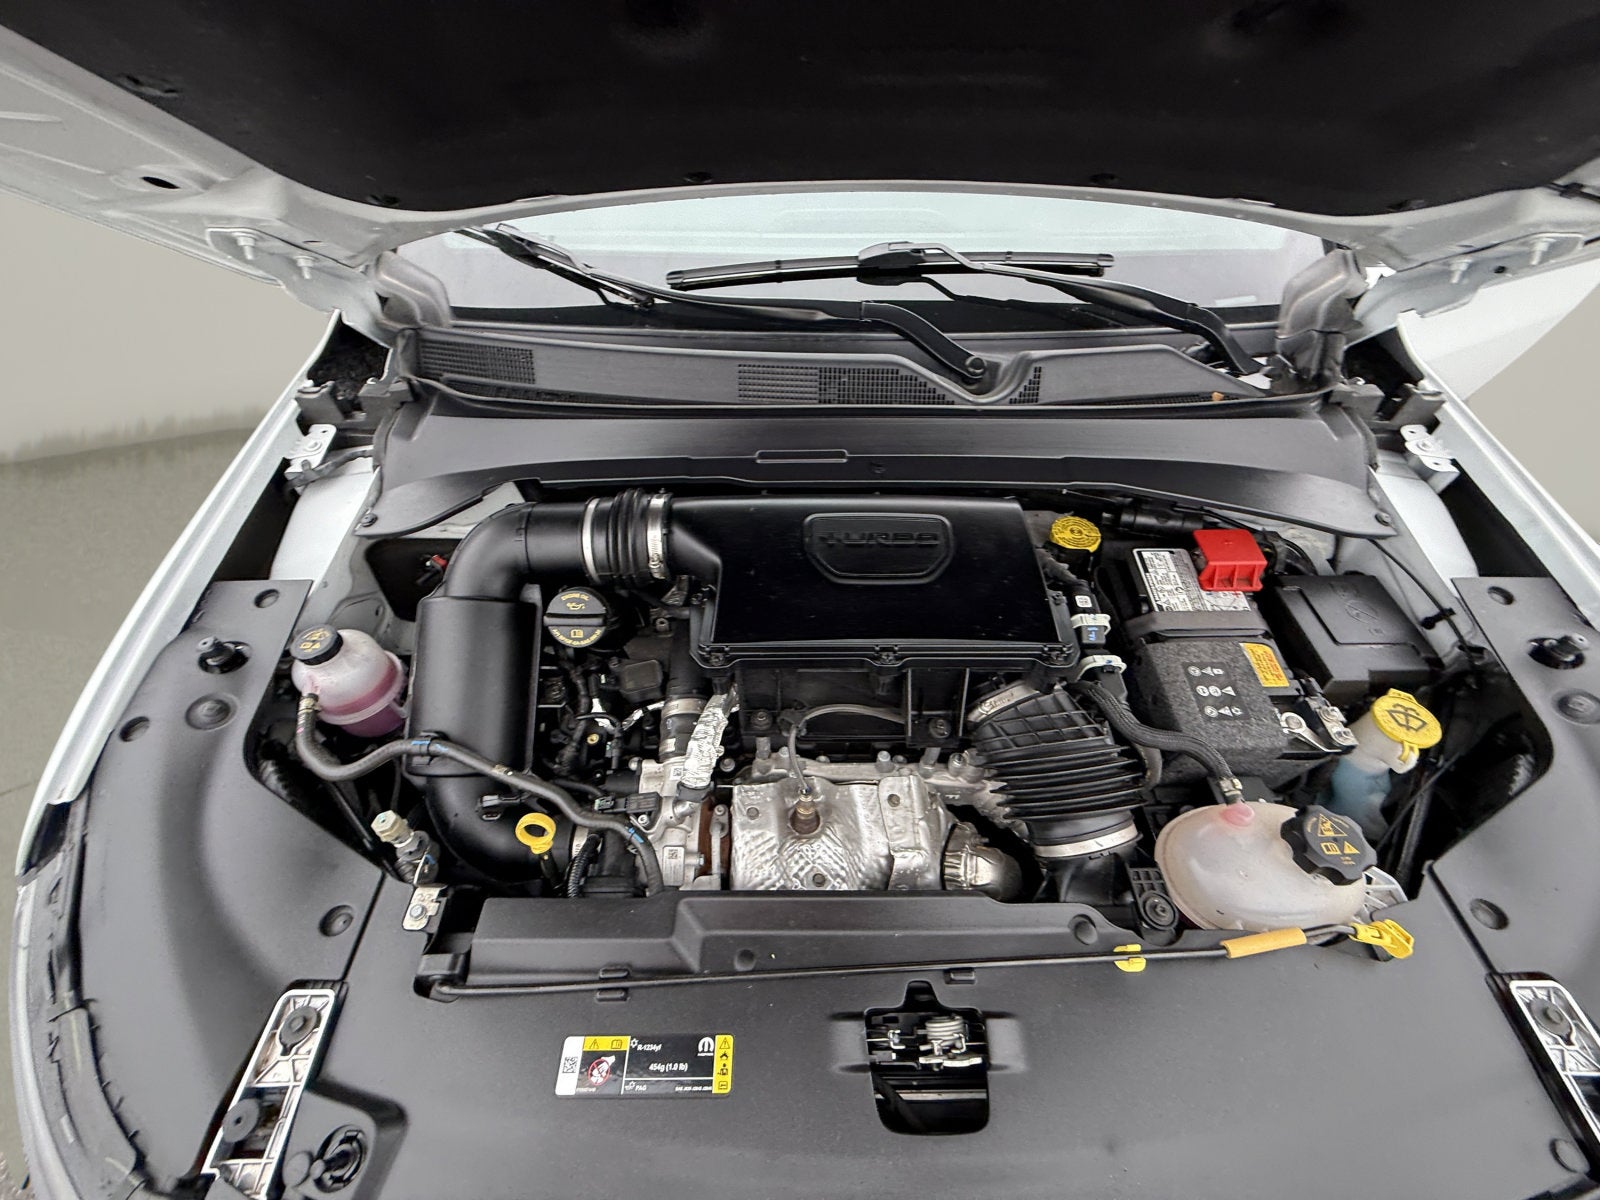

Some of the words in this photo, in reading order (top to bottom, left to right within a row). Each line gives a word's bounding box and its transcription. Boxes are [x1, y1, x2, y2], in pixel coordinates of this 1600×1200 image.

[817, 531, 941, 546] TURBO
[649, 1063, 665, 1072] 454g
[666, 1063, 678, 1072] (1.0
[679, 1063, 688, 1072] lb)
